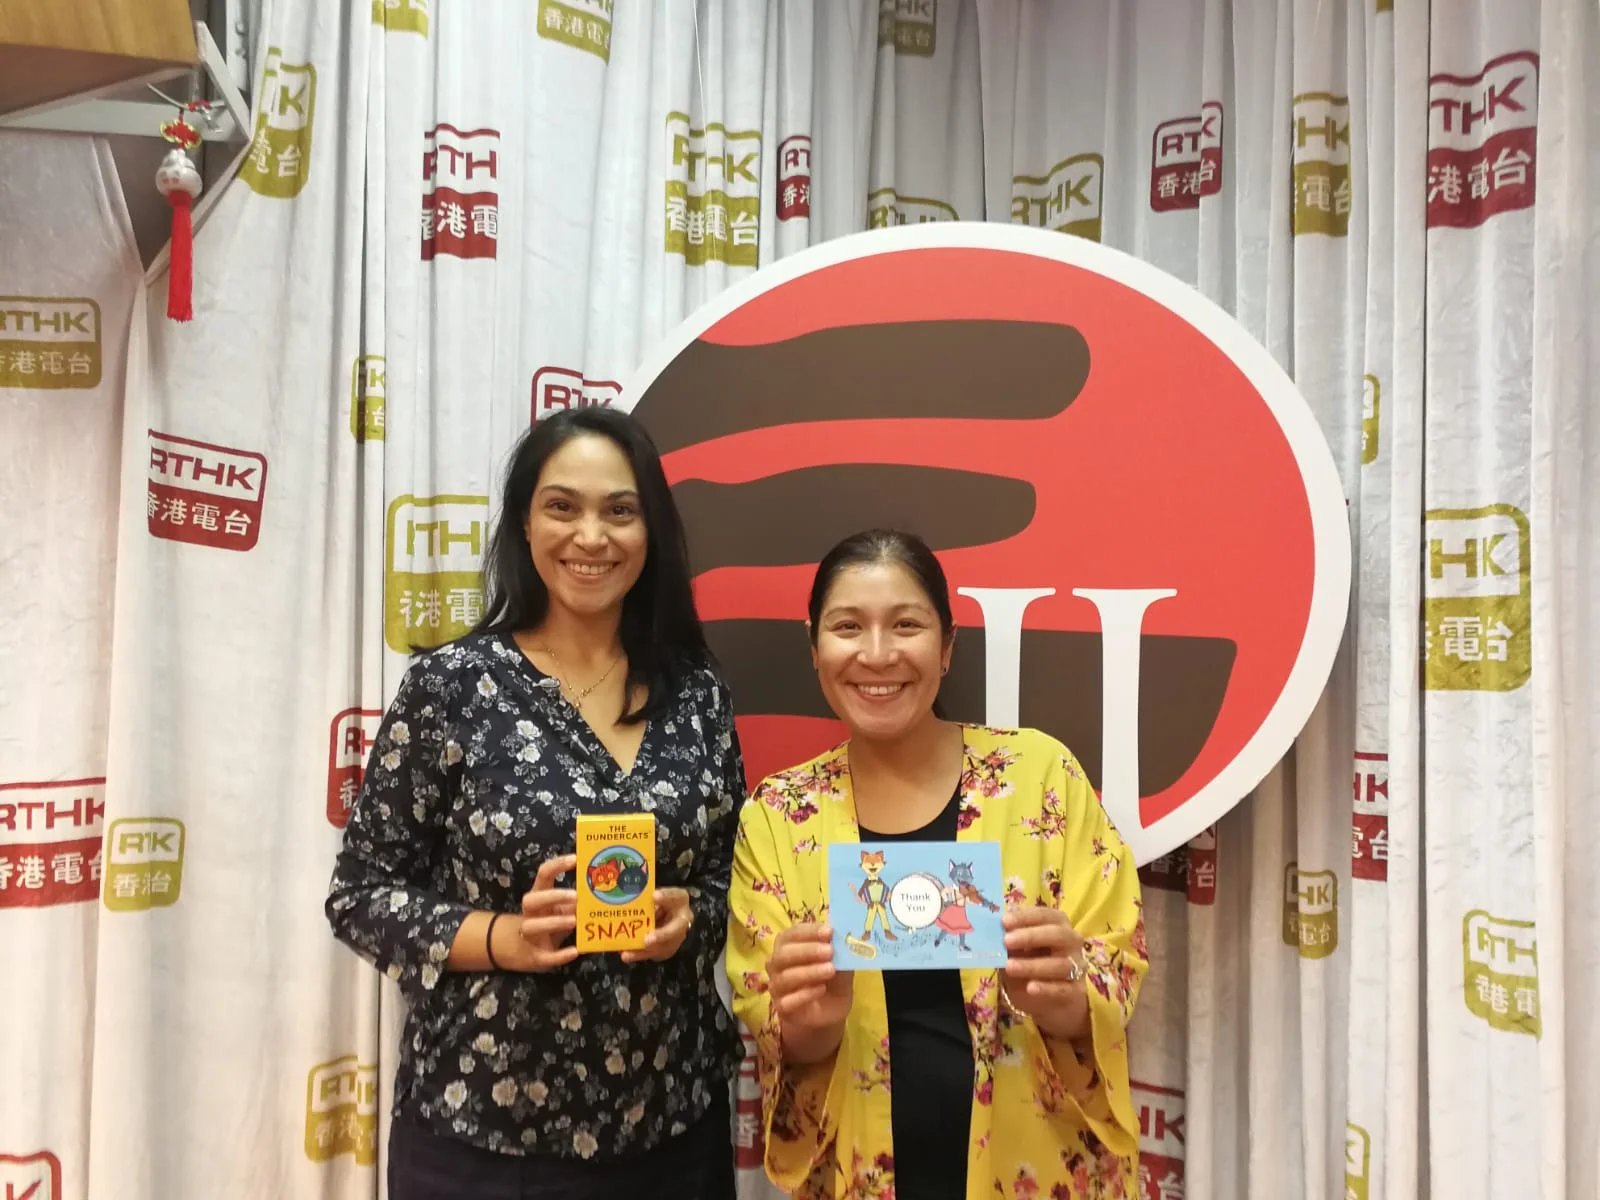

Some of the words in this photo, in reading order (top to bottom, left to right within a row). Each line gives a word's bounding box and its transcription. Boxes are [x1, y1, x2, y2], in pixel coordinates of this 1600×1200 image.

[0, 350, 92, 375] 港電台
[151, 446, 257, 491] RTHK
[406, 520, 489, 558] TH
[1425, 616, 1515, 662] 電台
[609, 825, 627, 833] THE
[586, 832, 649, 841] DUNDERCATS
[901, 892, 930, 901] Thank
[907, 903, 926, 912] You
[589, 908, 646, 919] ORCHESTRA
